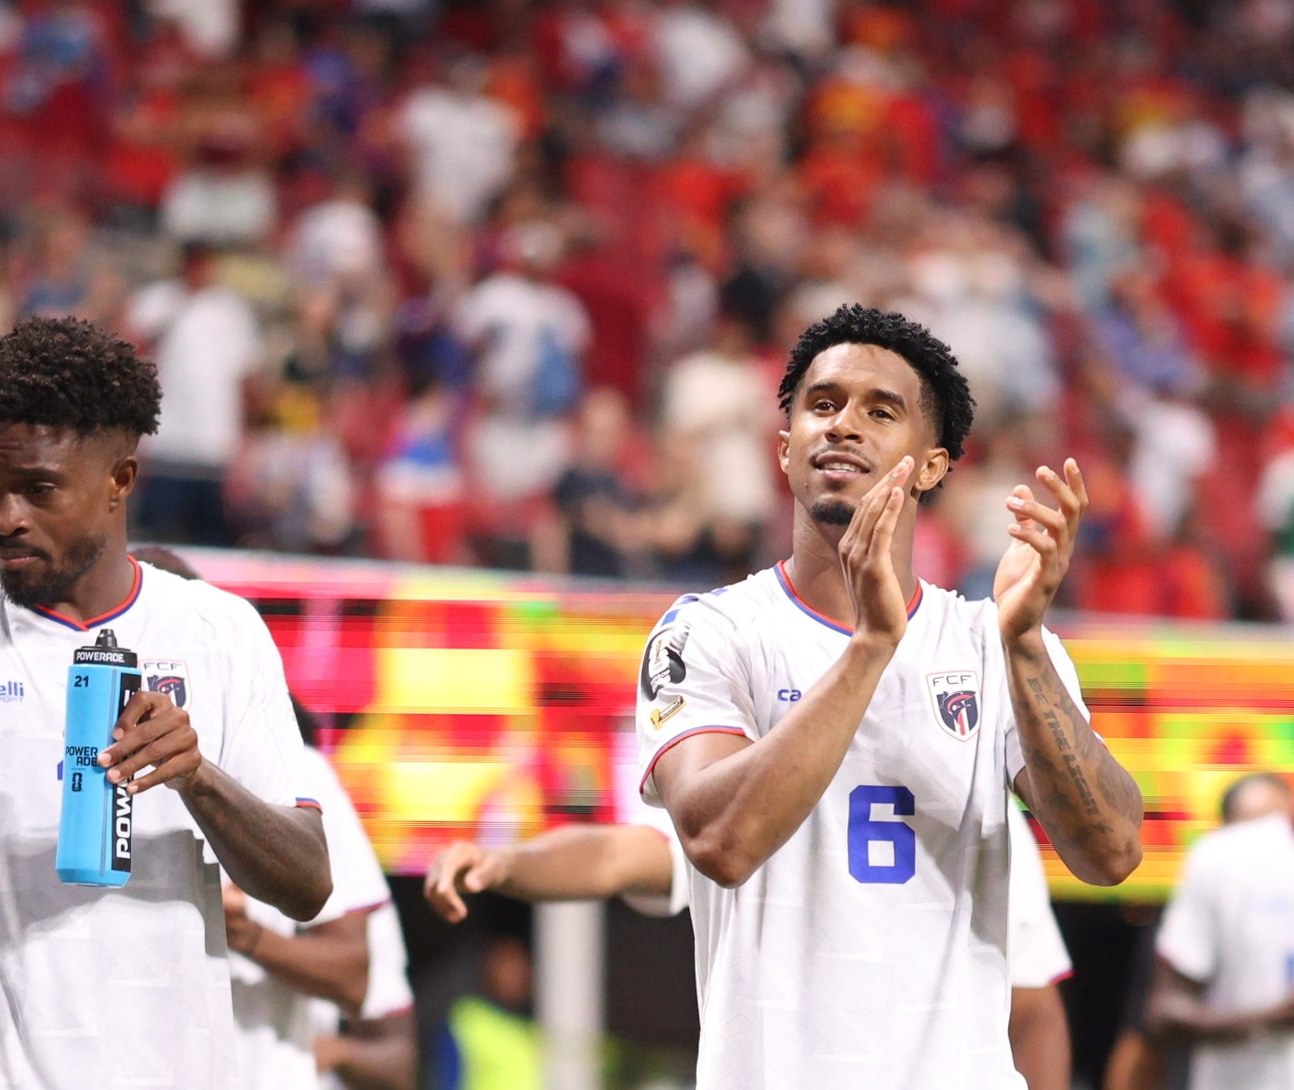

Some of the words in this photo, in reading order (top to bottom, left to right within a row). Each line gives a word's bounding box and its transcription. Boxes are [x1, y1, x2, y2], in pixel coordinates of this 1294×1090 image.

[76, 651, 125, 663] POWERADE
[144, 662, 182, 670] FCF
[74, 675, 89, 687] 21
[933, 675, 972, 687] FCF
[1027, 678, 1049, 705] BE
[1044, 709, 1071, 750] THE
[66, 746, 98, 756] POWER
[848, 785, 916, 884] 6
